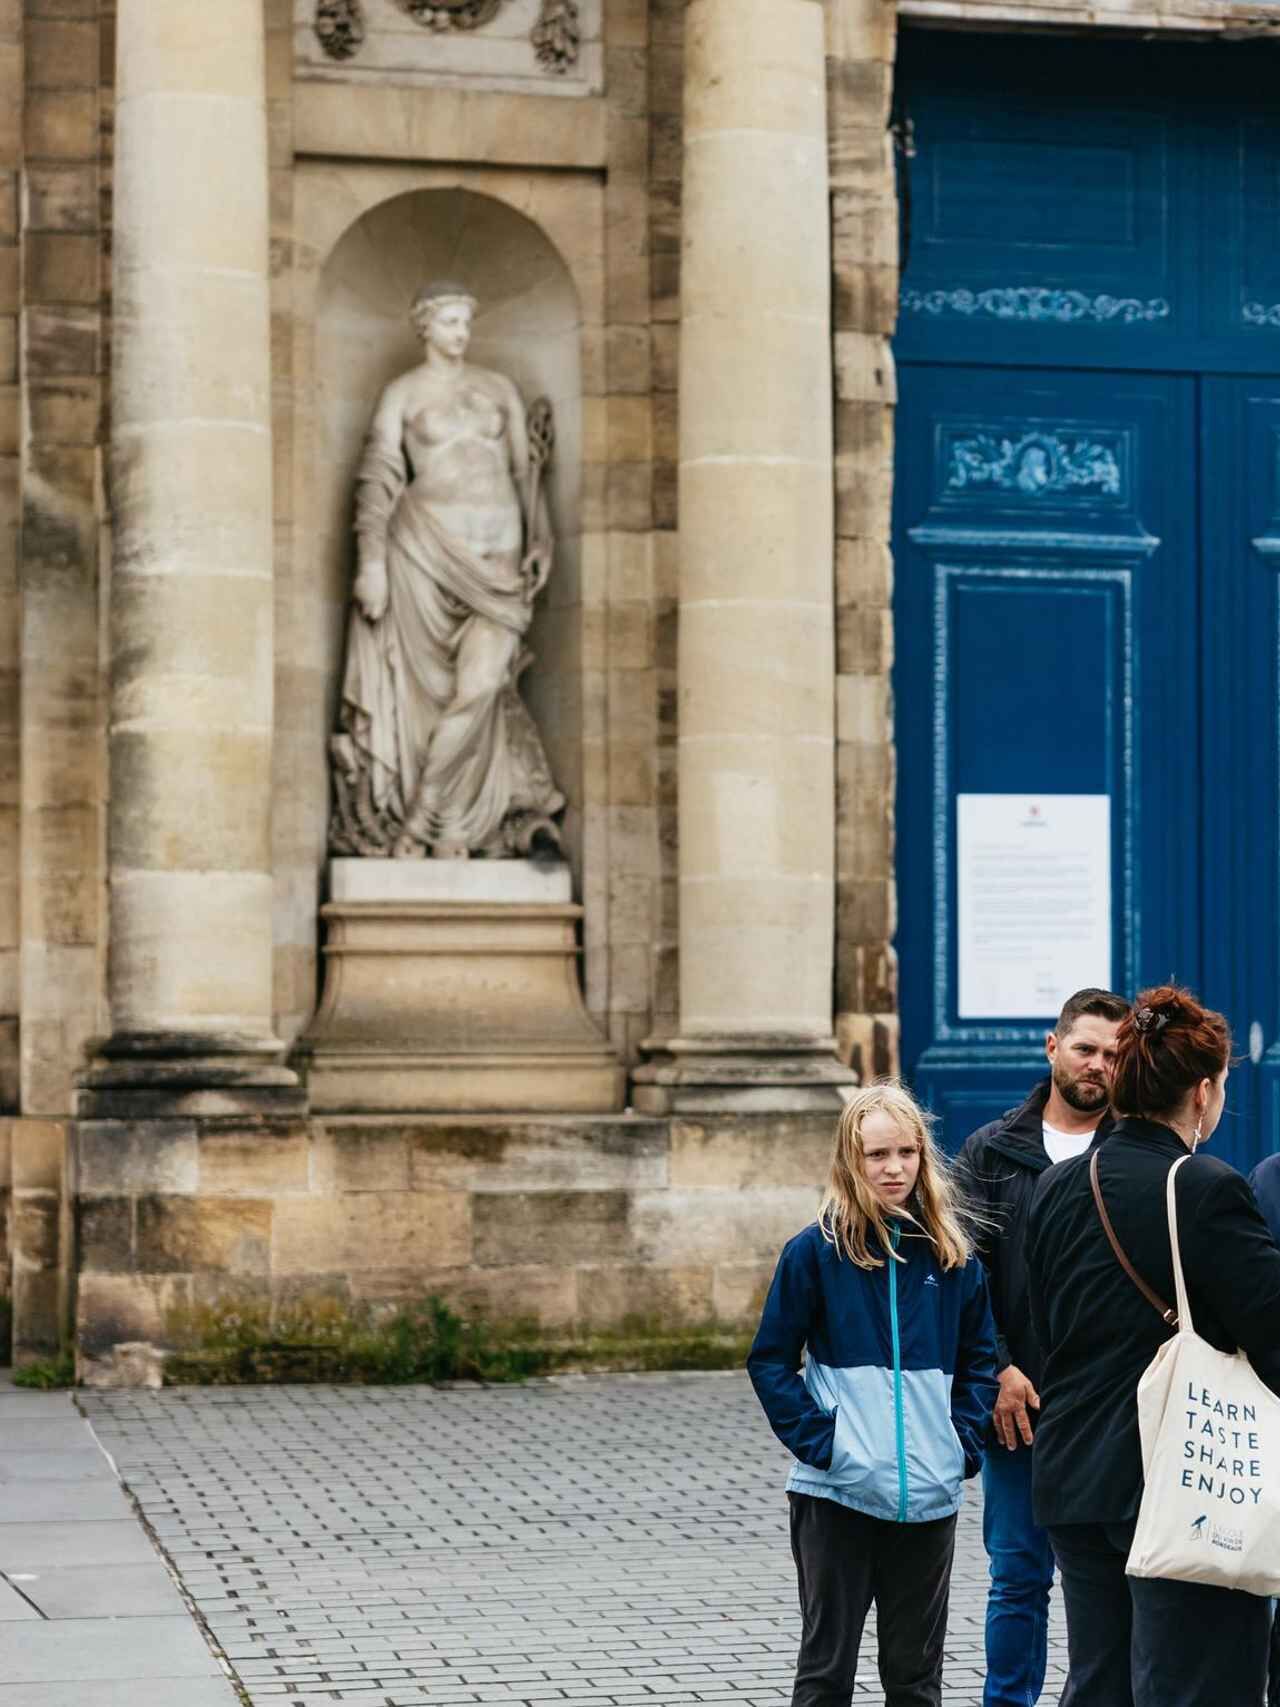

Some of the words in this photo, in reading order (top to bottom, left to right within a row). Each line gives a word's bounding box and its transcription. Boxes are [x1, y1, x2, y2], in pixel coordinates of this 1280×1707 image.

[1188, 1382, 1256, 1421] LEARN
[1186, 1411, 1259, 1450] TASTE
[1184, 1440, 1261, 1477] SHARE
[1181, 1469, 1263, 1504] ENJOY
